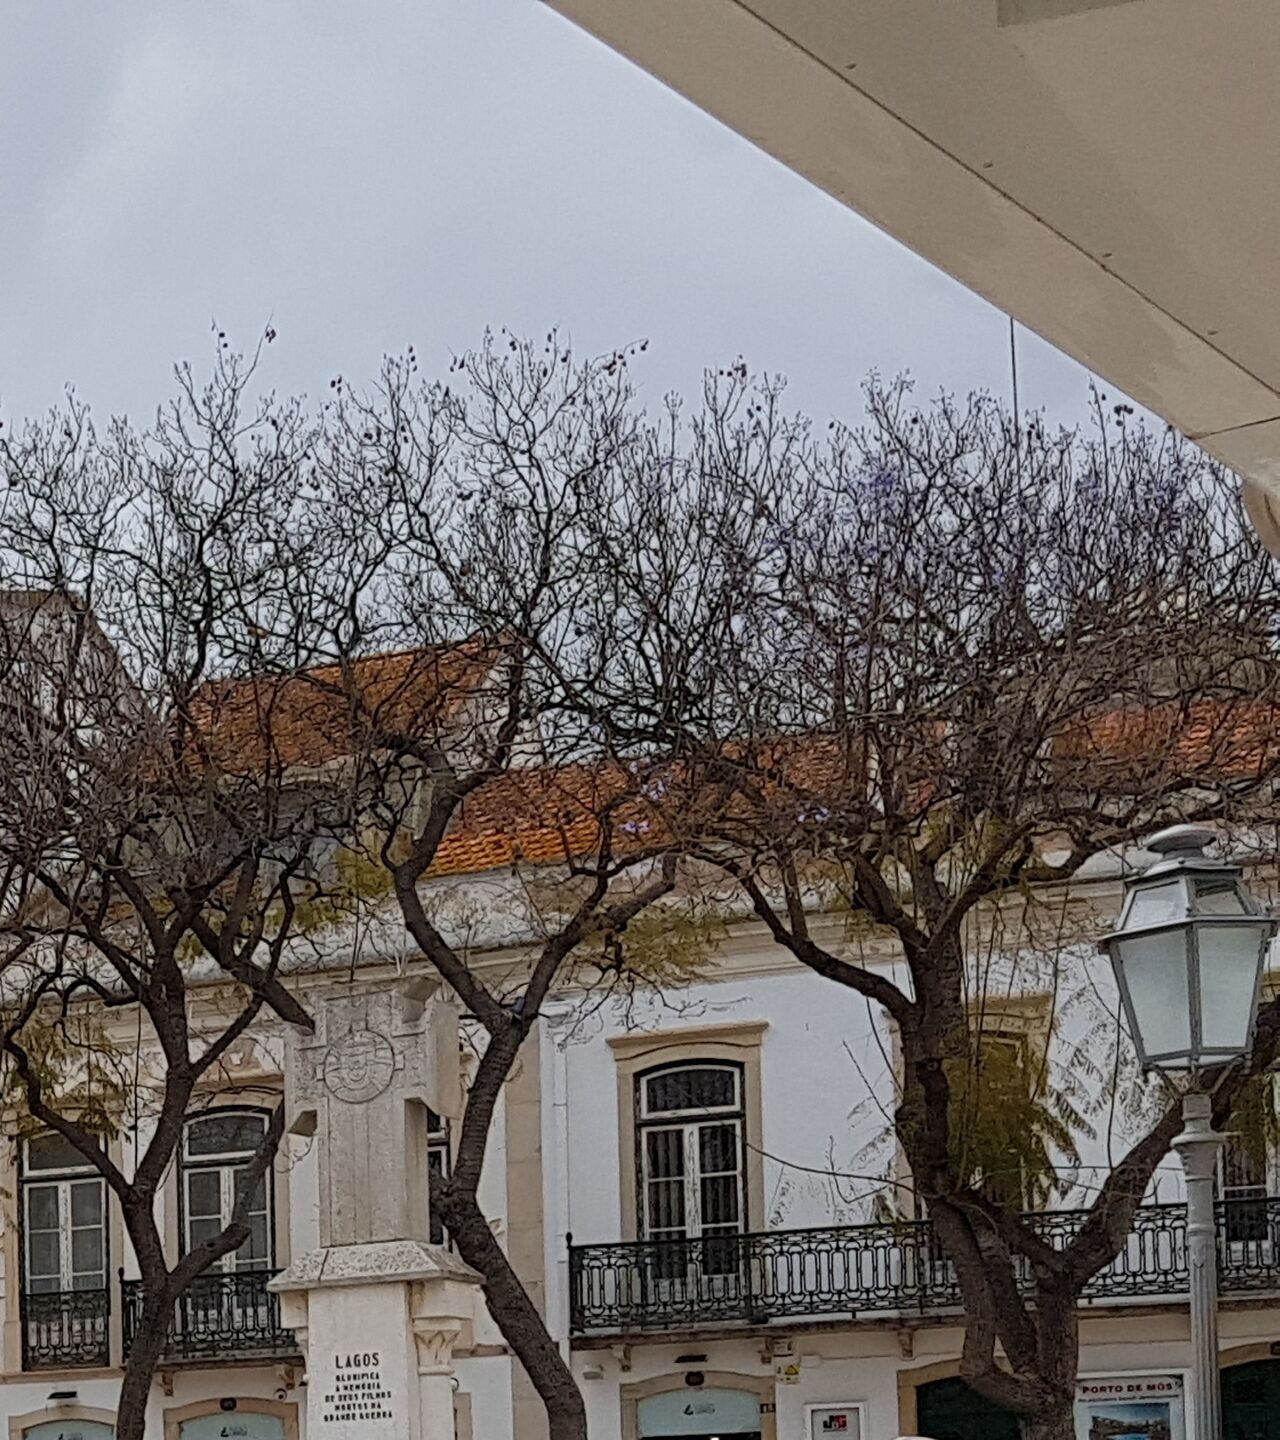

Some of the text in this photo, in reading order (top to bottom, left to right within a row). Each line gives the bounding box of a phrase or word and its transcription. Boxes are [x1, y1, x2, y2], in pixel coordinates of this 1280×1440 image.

[335, 1352, 380, 1369] LAGOS
[1082, 1385, 1123, 1394] PORTO
[1127, 1384, 1142, 1392] DE
